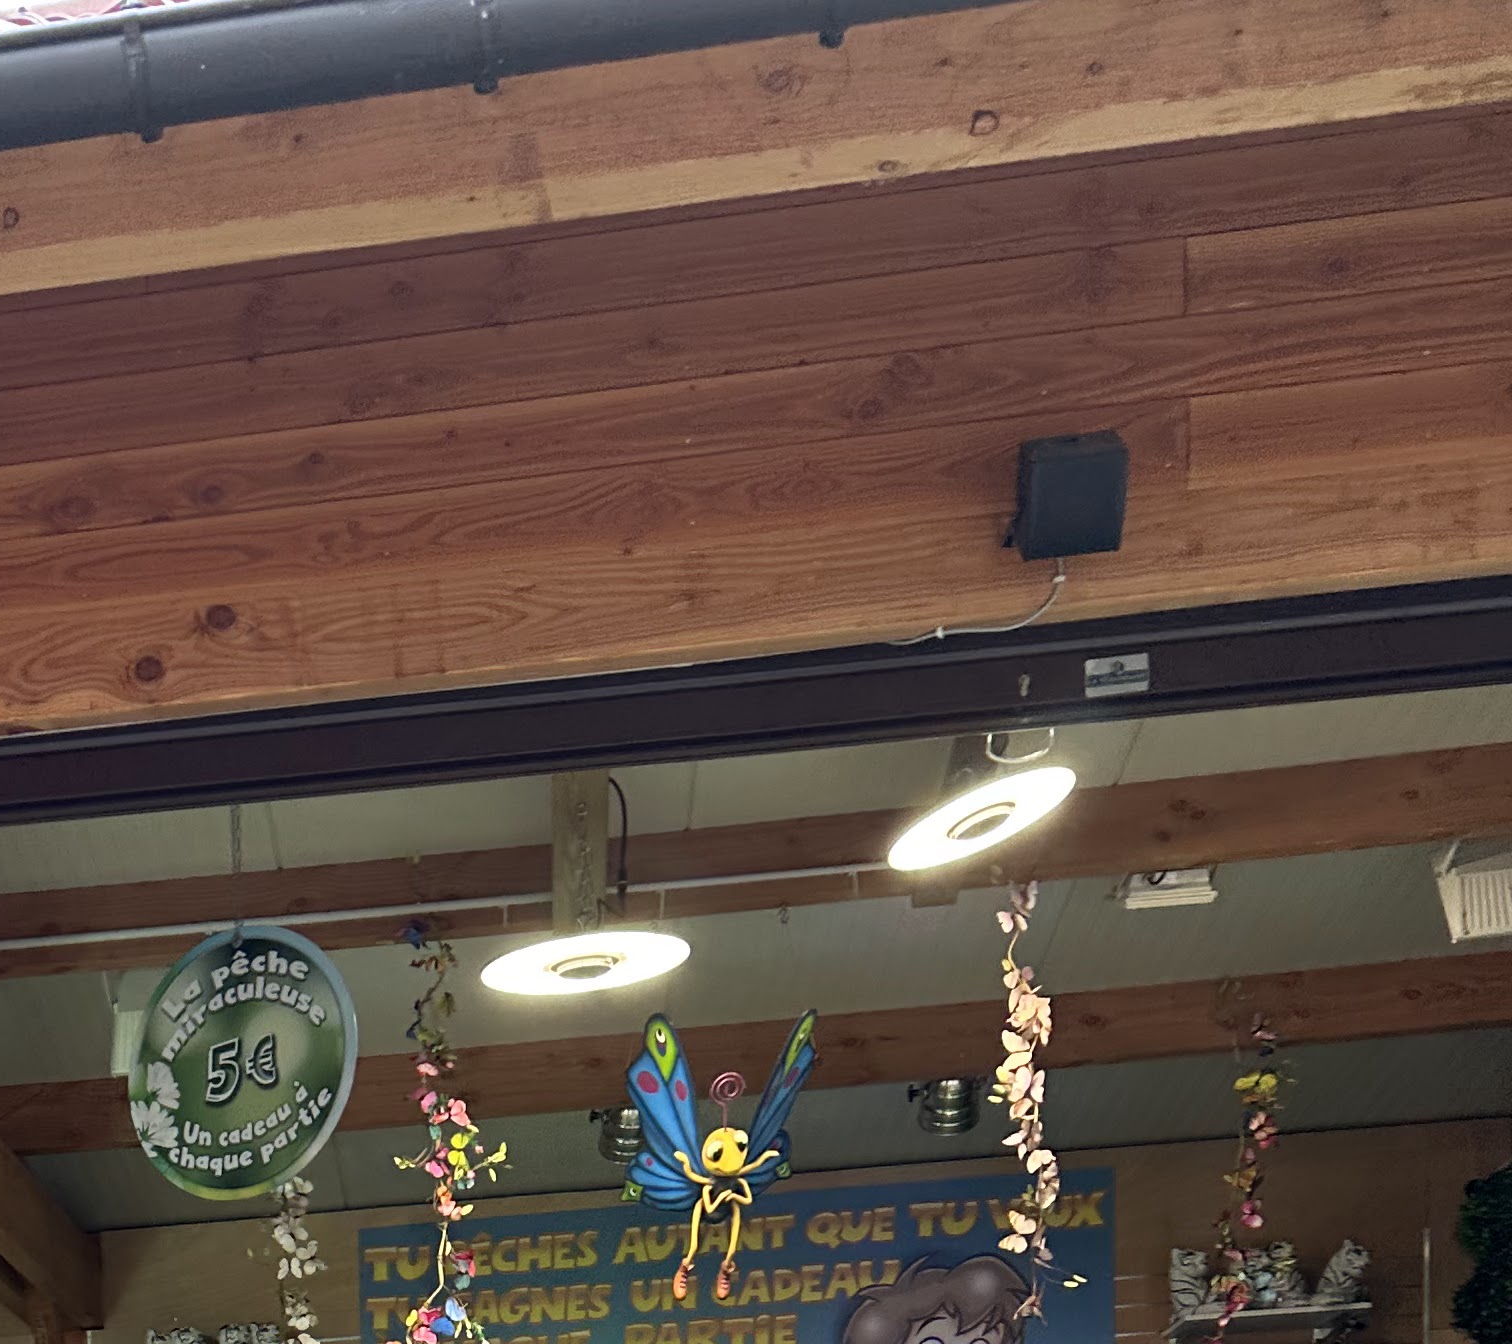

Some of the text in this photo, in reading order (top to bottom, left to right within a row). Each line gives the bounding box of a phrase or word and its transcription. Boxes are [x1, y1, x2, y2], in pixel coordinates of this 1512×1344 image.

[161, 950, 310, 1022] La pêche
[161, 976, 327, 1063] miraculeuse
[168, 1087, 332, 1177] chaque partie
[184, 1081, 308, 1148] Un cadeau à
[364, 1245, 430, 1281] TU
[613, 1214, 795, 1264] AUTANT
[806, 1206, 895, 1249] QUE
[909, 1201, 978, 1237] TU
[987, 1190, 1105, 1230] VUX
[451, 1283, 612, 1325] AGNES
[630, 1276, 698, 1312] UN
